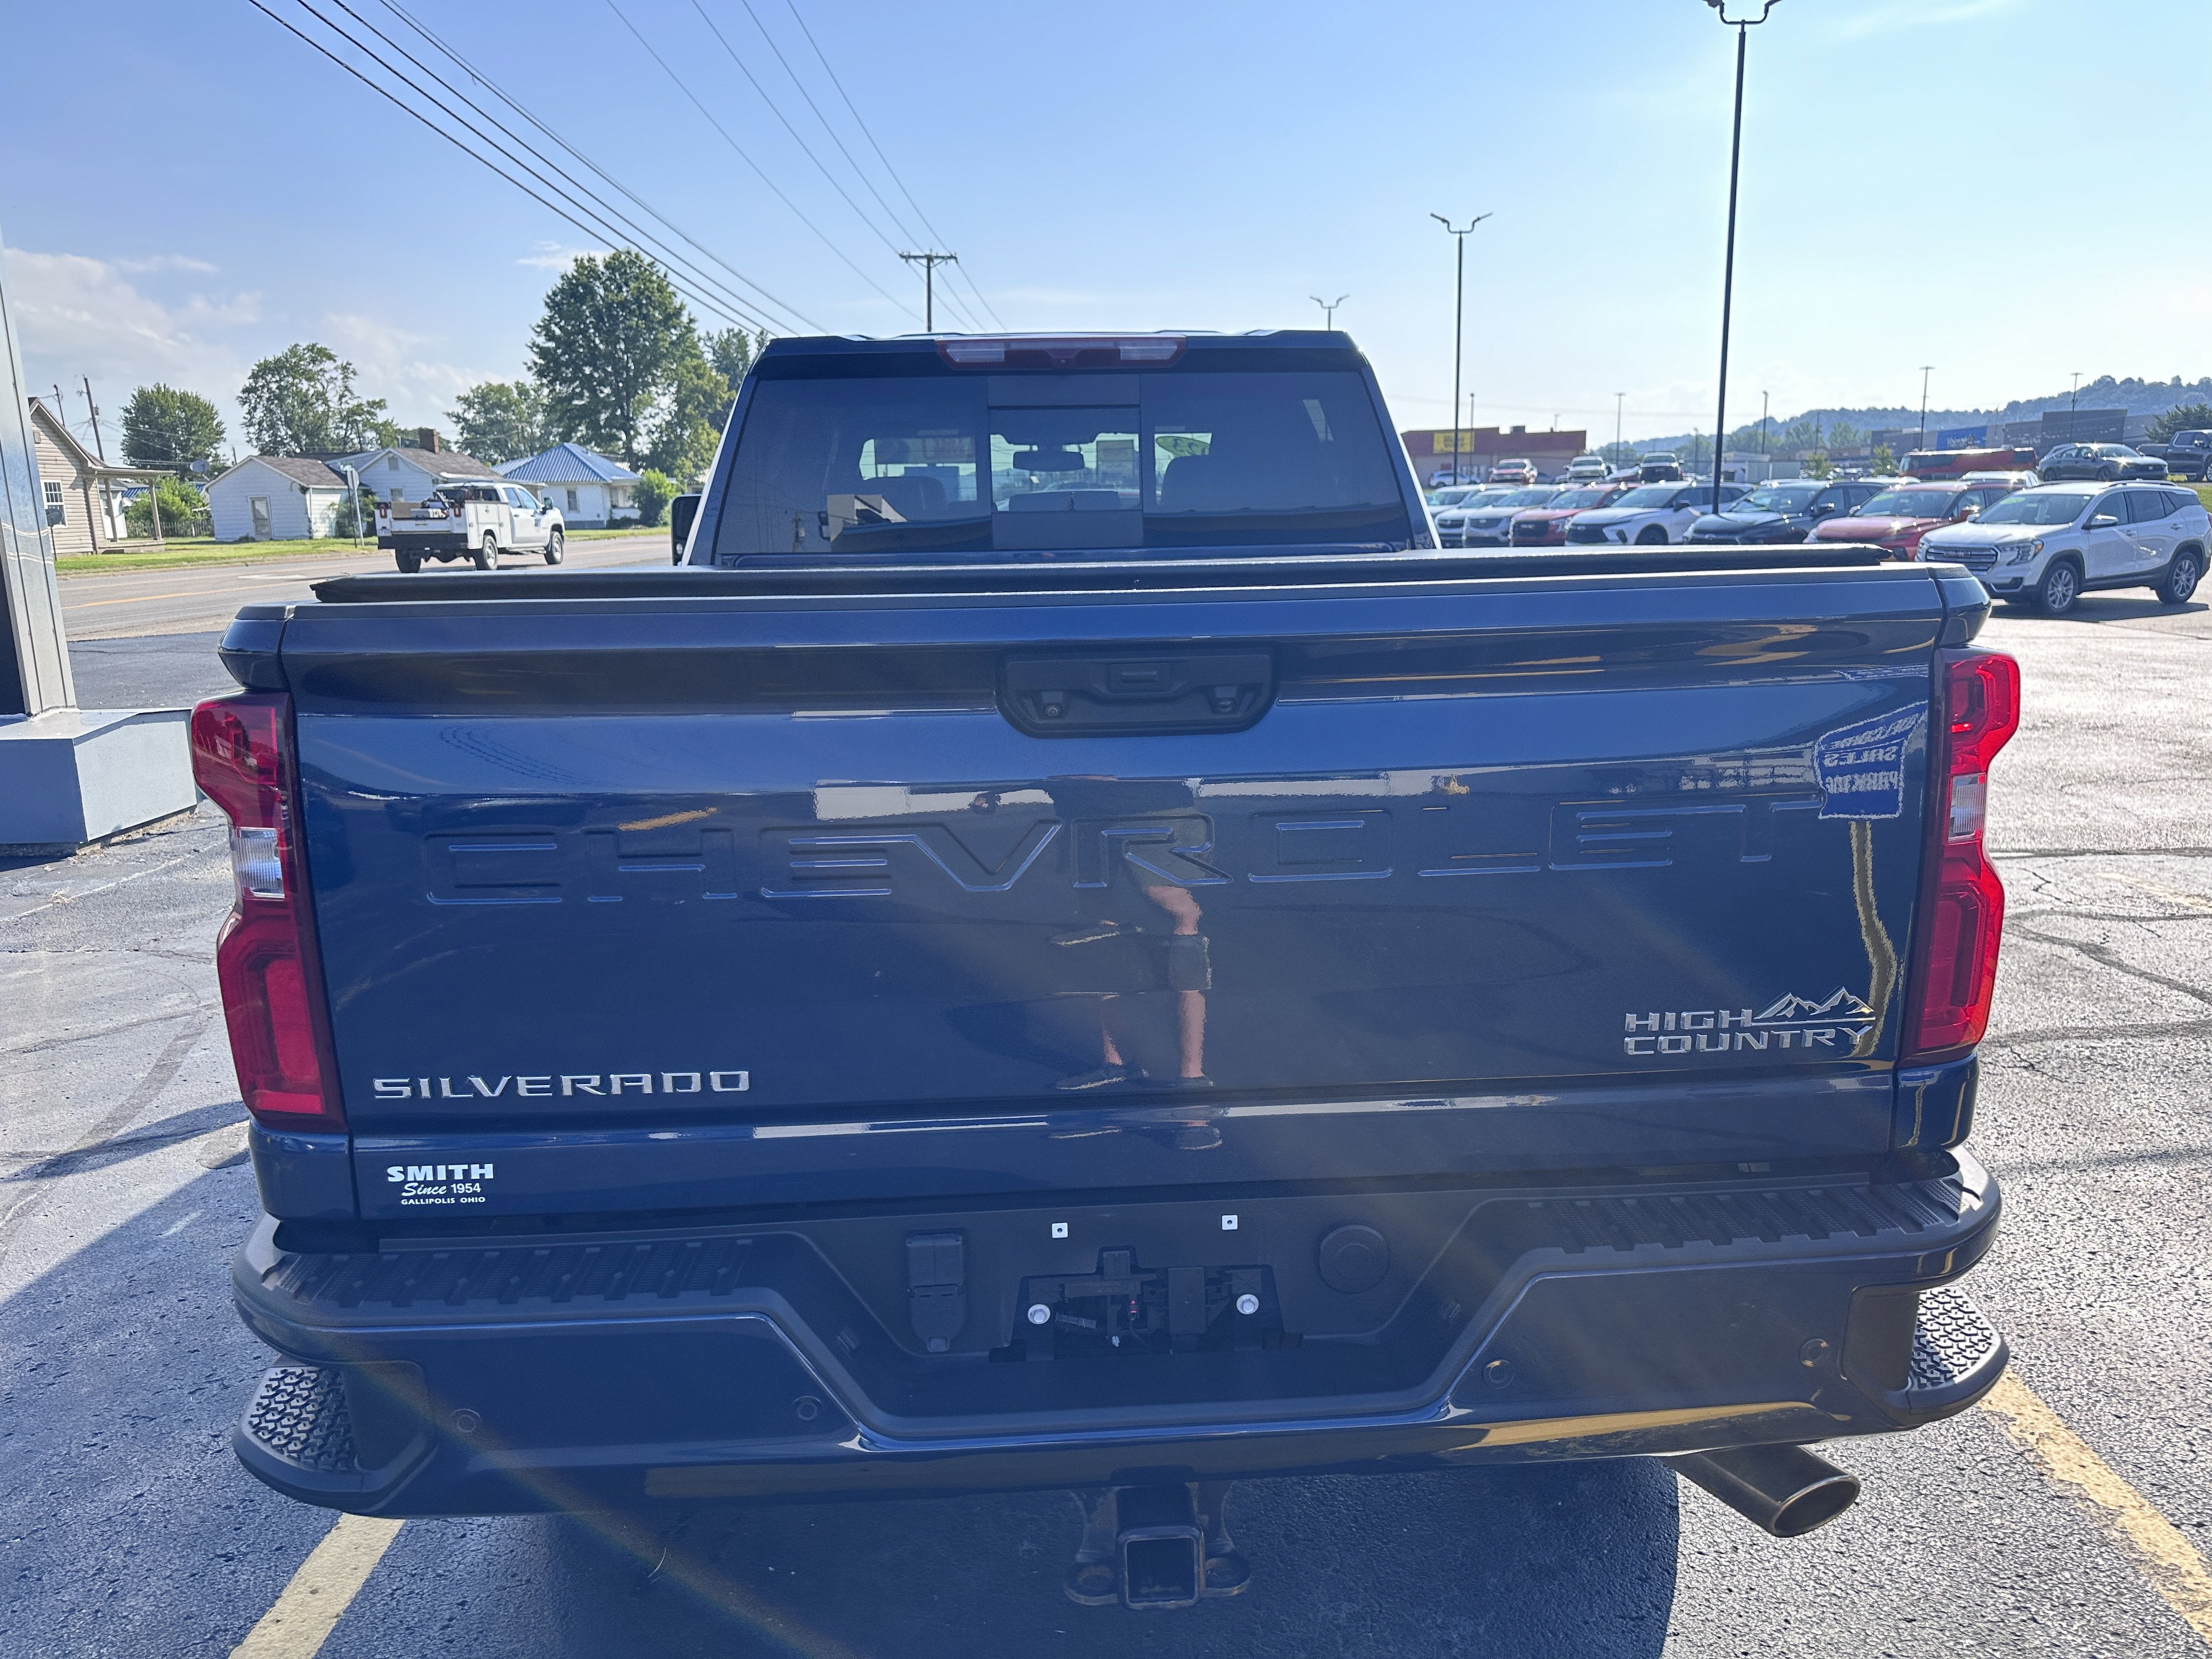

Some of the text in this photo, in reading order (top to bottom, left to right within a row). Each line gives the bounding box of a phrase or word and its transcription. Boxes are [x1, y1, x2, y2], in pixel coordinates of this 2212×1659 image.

[424, 791, 1826, 905] CHEVROLET
[1624, 1008, 1753, 1032] HIGH
[1624, 1025, 1873, 1055] COUNTRY
[373, 1070, 750, 1099] SILVERADO
[387, 1163, 494, 1182] SMITH
[401, 1182, 482, 1197] Since 1954
[401, 1197, 455, 1205] GALLIPOLIS
